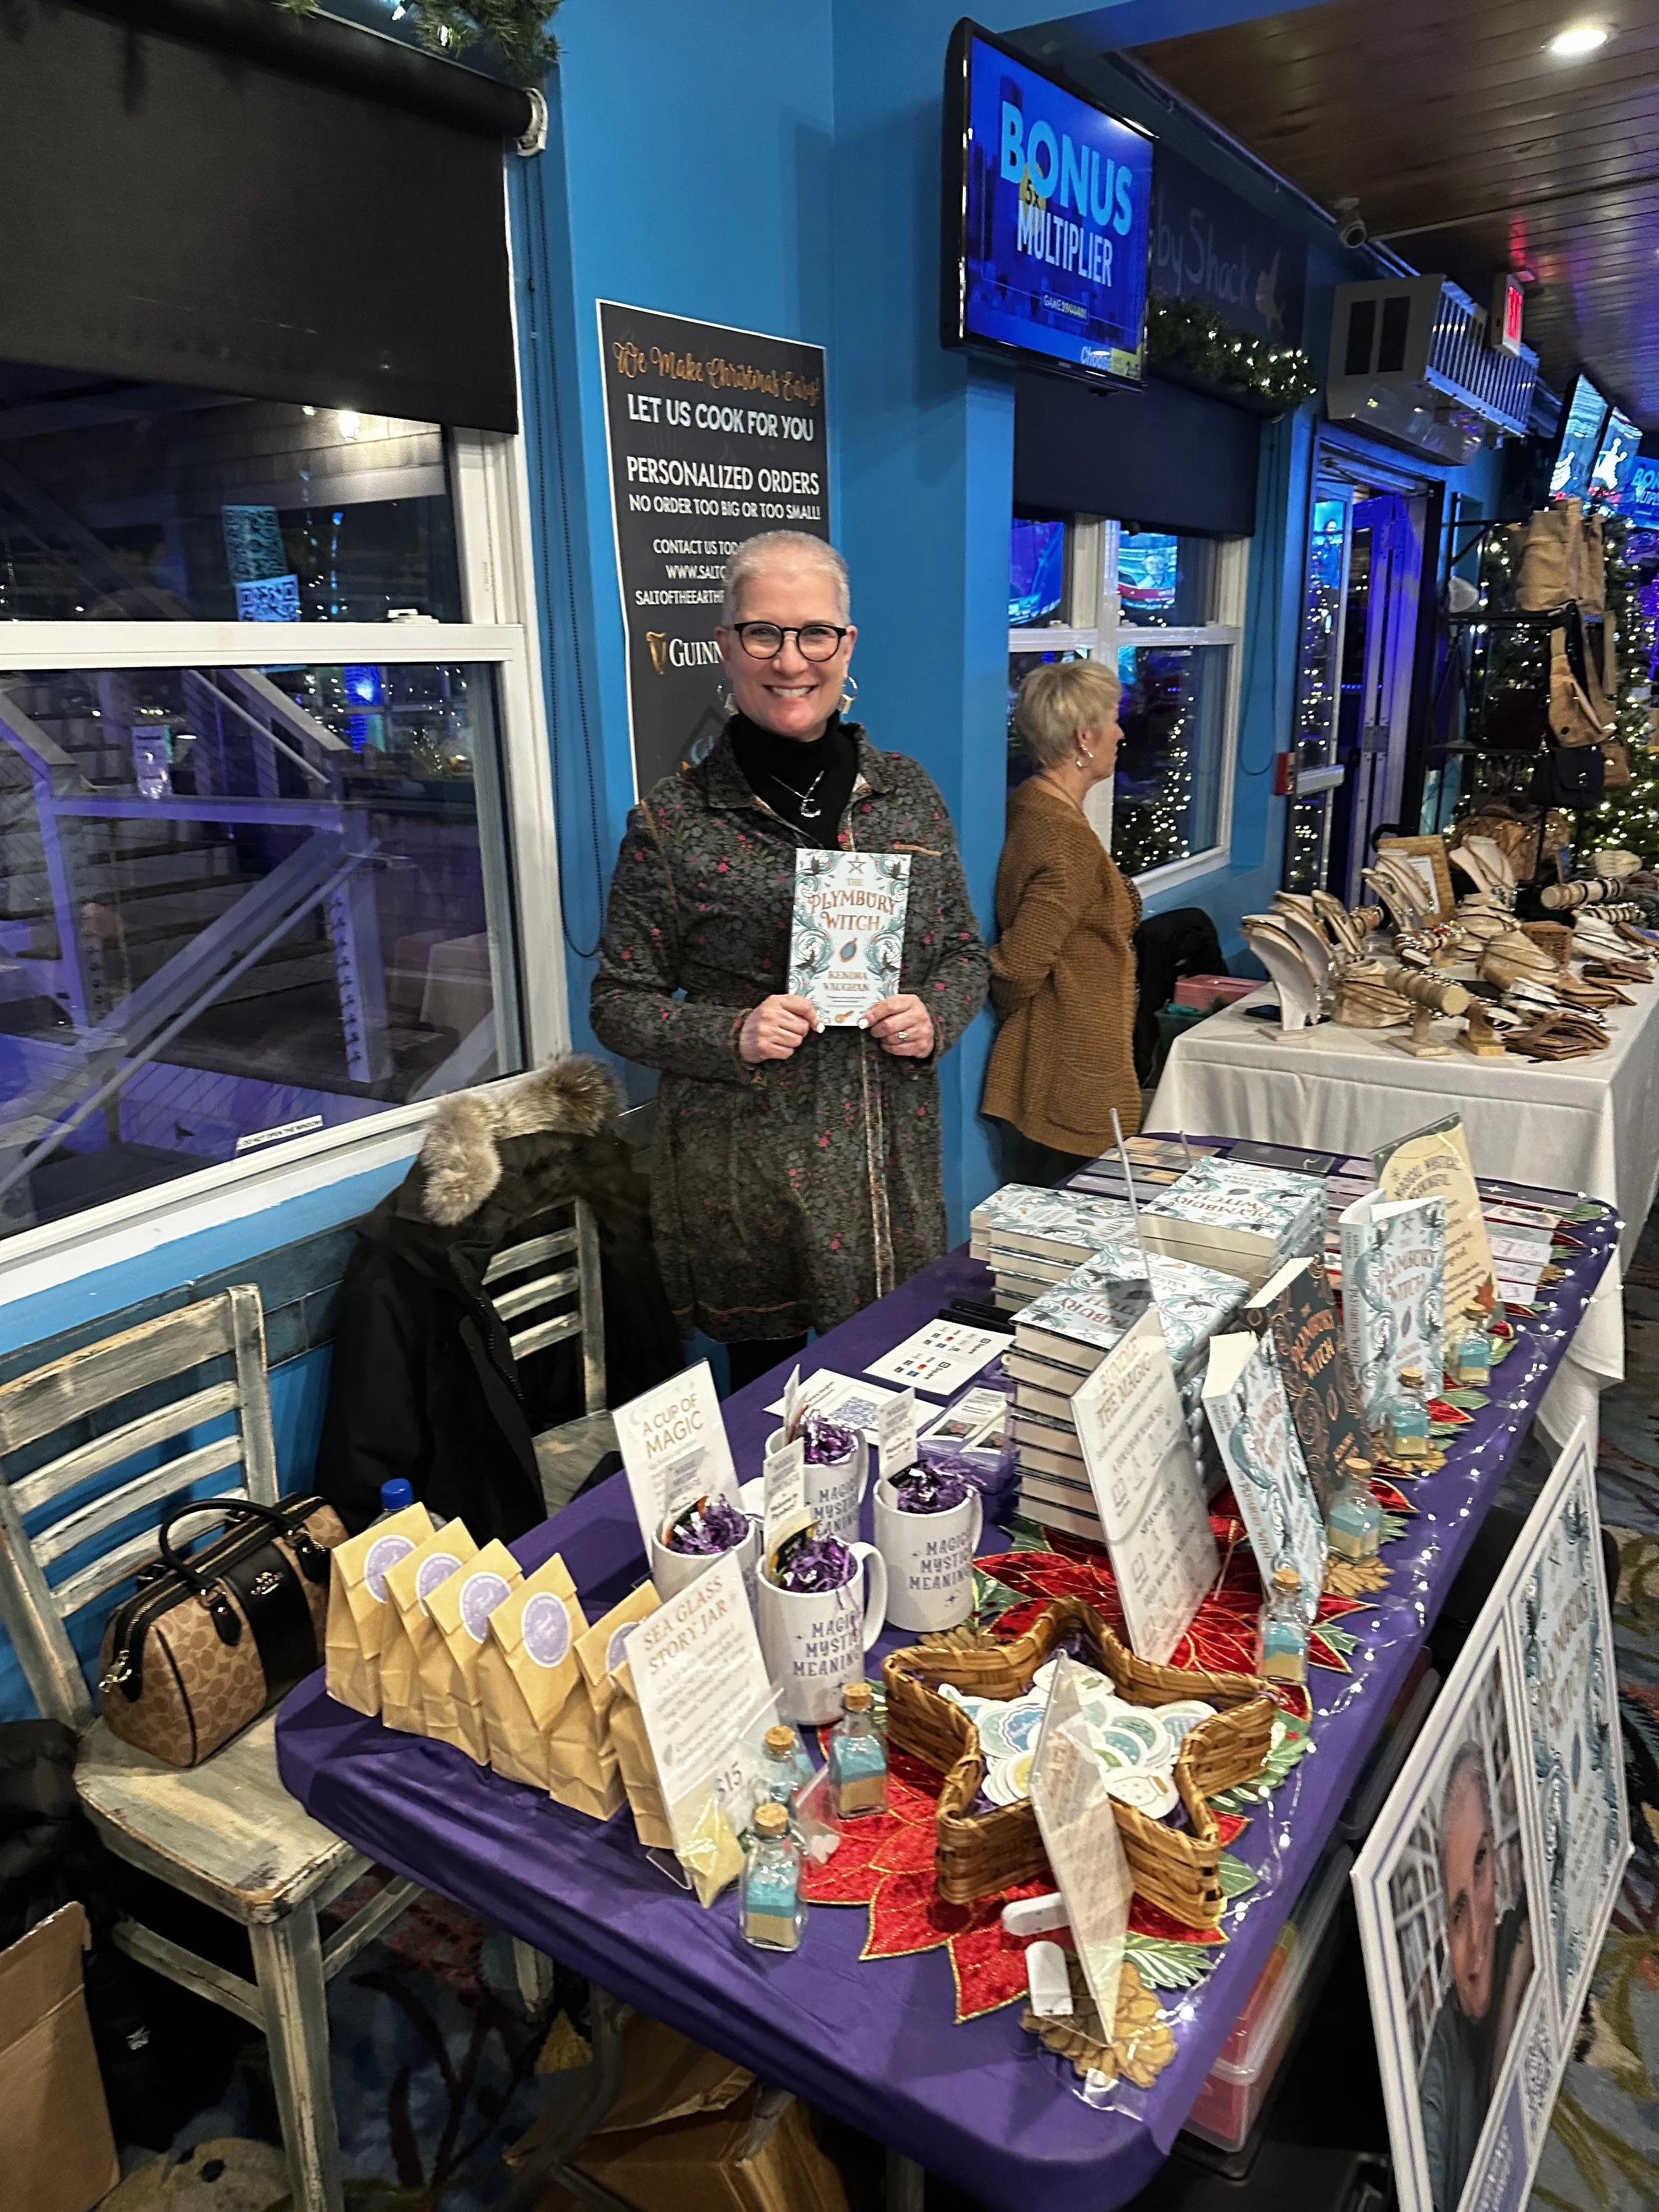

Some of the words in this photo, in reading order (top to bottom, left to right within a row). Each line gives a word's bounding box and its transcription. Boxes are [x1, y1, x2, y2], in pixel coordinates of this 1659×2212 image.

[1001, 100, 1133, 236] BONUS
[1017, 200, 1113, 287] MULTIPLIER
[613, 342, 648, 378] We
[650, 346, 703, 382] Make
[706, 358, 779, 398] Christmas
[627, 394, 662, 423] LET
[666, 400, 691, 427] US
[695, 403, 745, 433] COOK
[747, 411, 778, 437] FOR
[780, 416, 814, 441] YOU
[626, 456, 753, 490] PERSONALIZED
[758, 469, 820, 495] ORDERS
[628, 494, 651, 512] NO
[654, 496, 692, 514] ORDER
[693, 498, 719, 516] TOO
[721, 500, 739, 517] BIG
[741, 502, 758, 518] OR
[760, 503, 784, 519] TOO
[653, 539, 702, 555] CONTACT
[703, 541, 717, 555] US
[718, 541, 740, 555] TOD
[668, 638, 724, 667] GUINN
[808, 890, 897, 915] PLYMBURY
[820, 911, 880, 930] WITCH
[1172, 1195, 1275, 1218] PLYMBURY
[1193, 1193, 1263, 1211] WITCH
[1060, 1297, 1131, 1326] MBURY
[1084, 1295, 1137, 1317] ITCH
[643, 1422, 653, 1437] A
[654, 1404, 679, 1428] CUP
[681, 1393, 698, 1412] OF
[646, 1411, 704, 1459] MAGIC
[644, 1618, 674, 1651] SEA
[676, 1576, 723, 1623] GLASS
[648, 1621, 699, 1676] STORY
[700, 1598, 729, 1635] JAR
